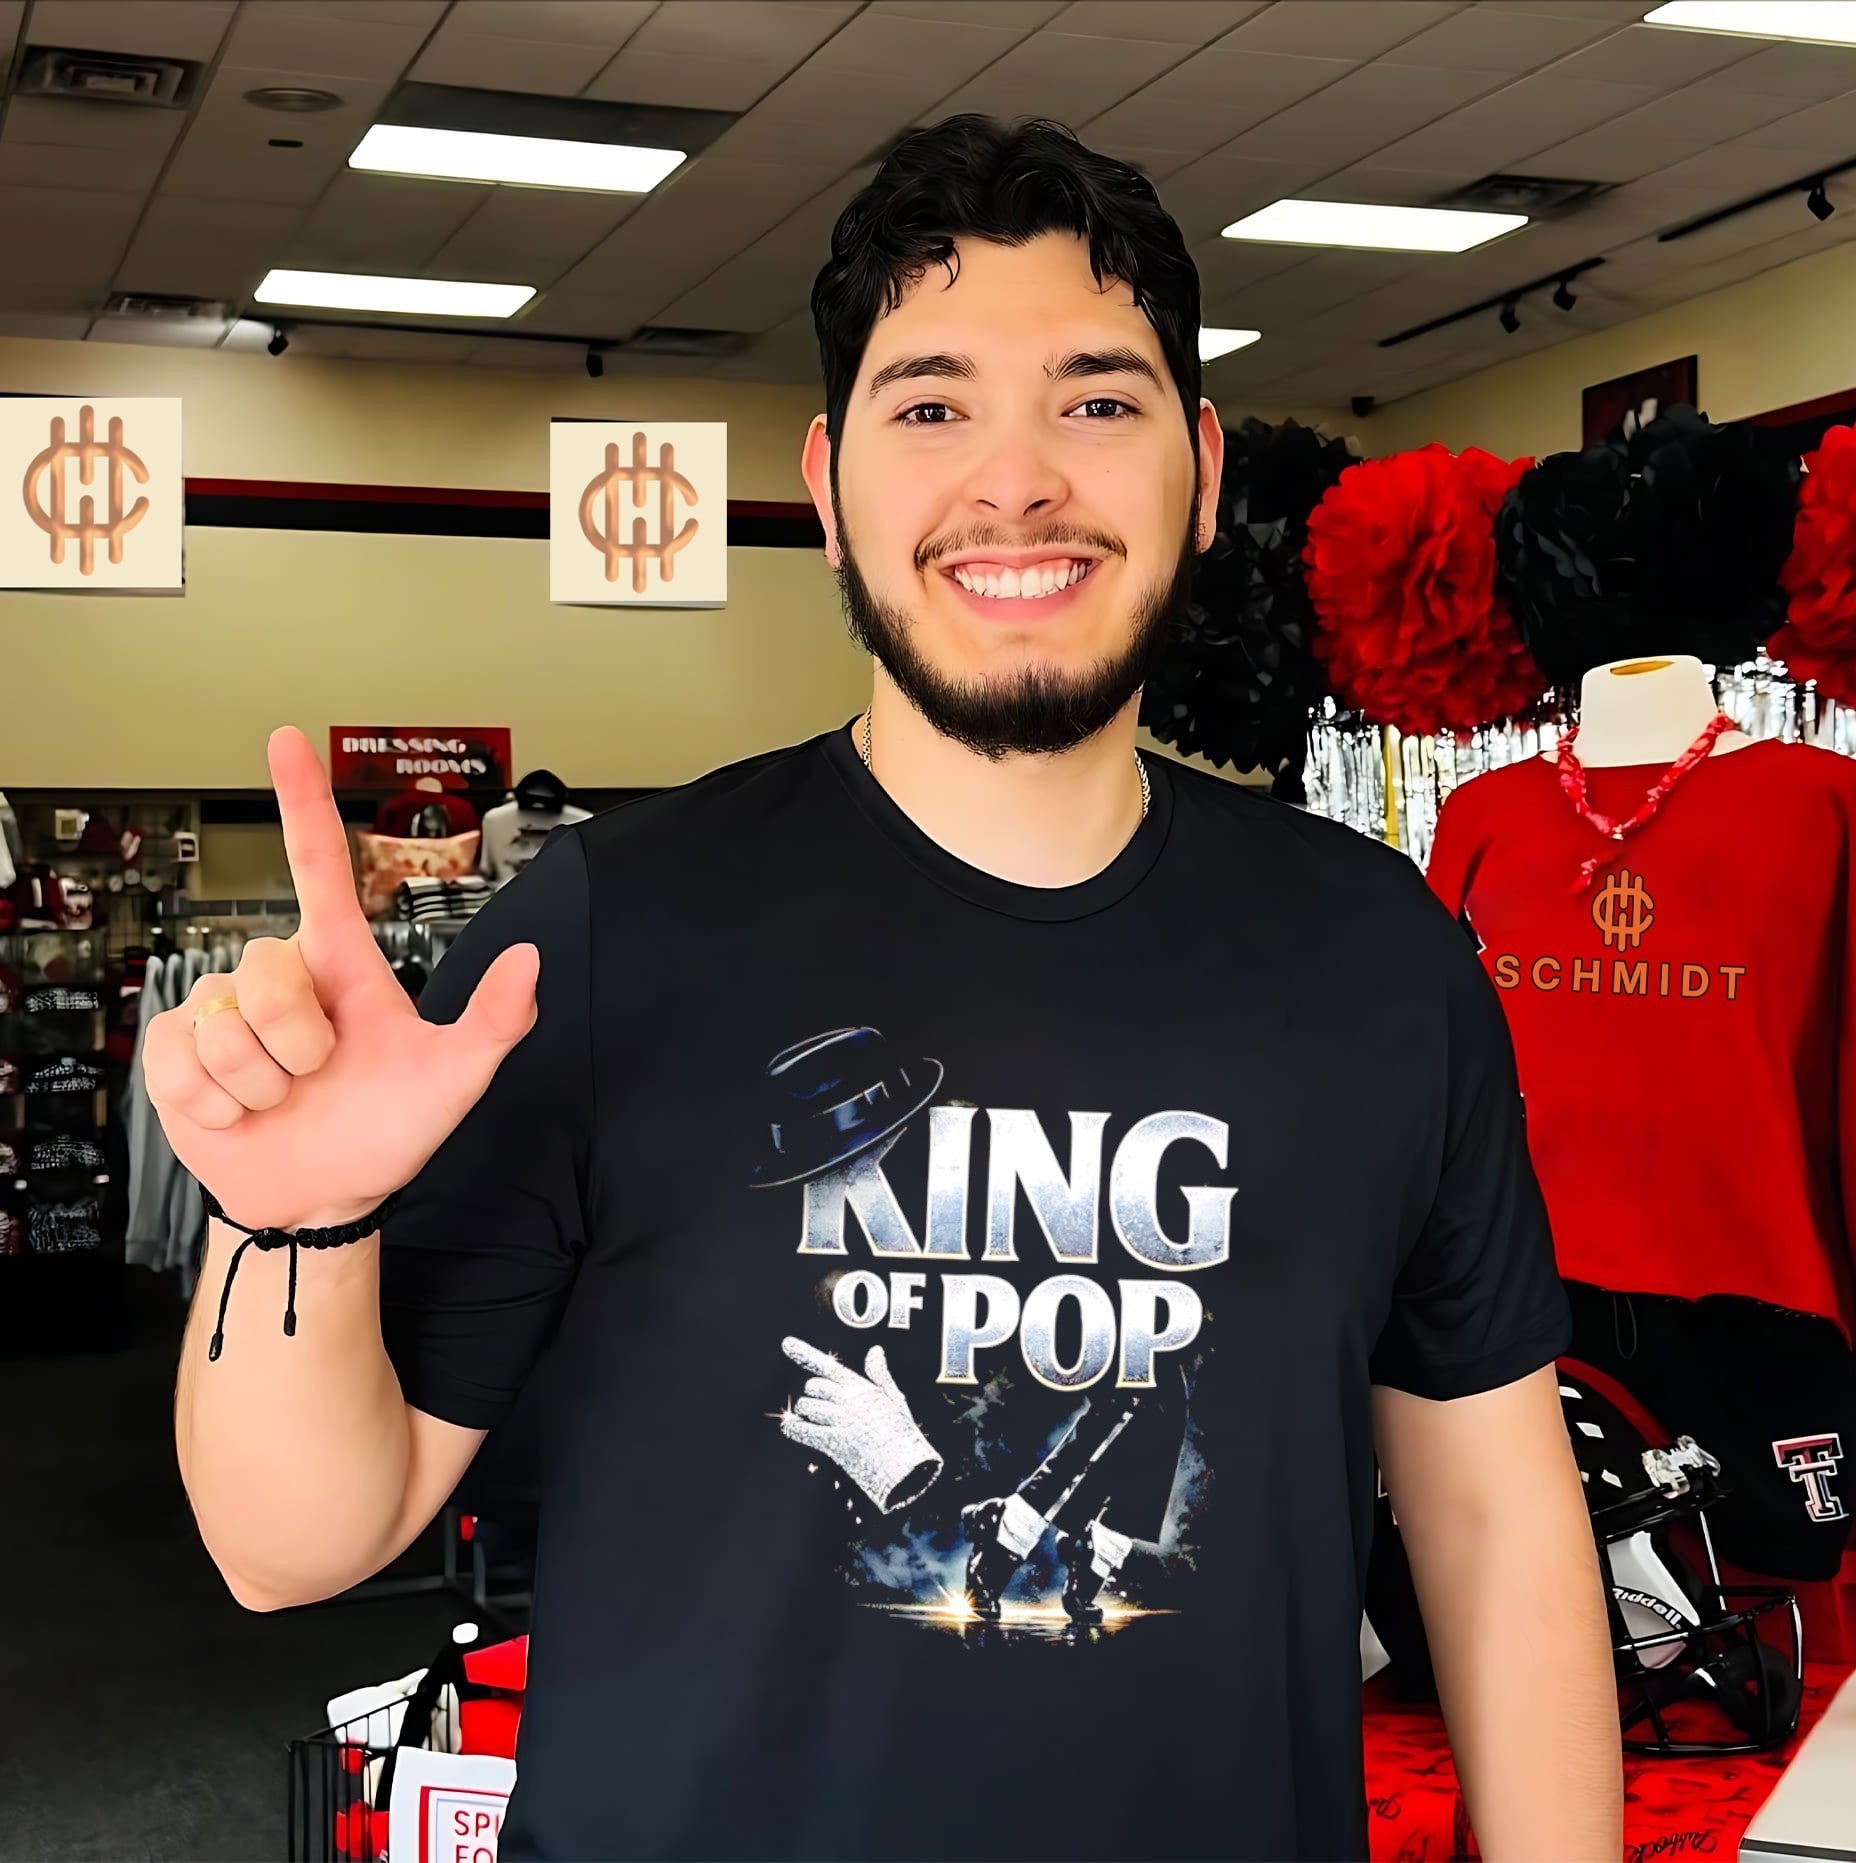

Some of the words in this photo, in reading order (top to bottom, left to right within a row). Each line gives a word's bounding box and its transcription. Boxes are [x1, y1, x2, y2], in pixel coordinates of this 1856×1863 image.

[342, 737, 466, 754] DRESSING
[396, 758, 487, 775] ROOMS
[1494, 954, 1746, 1000] SCHMIDT
[796, 1105, 1239, 1272] KING
[832, 1269, 926, 1329] OF
[936, 1273, 1203, 1391] POP
